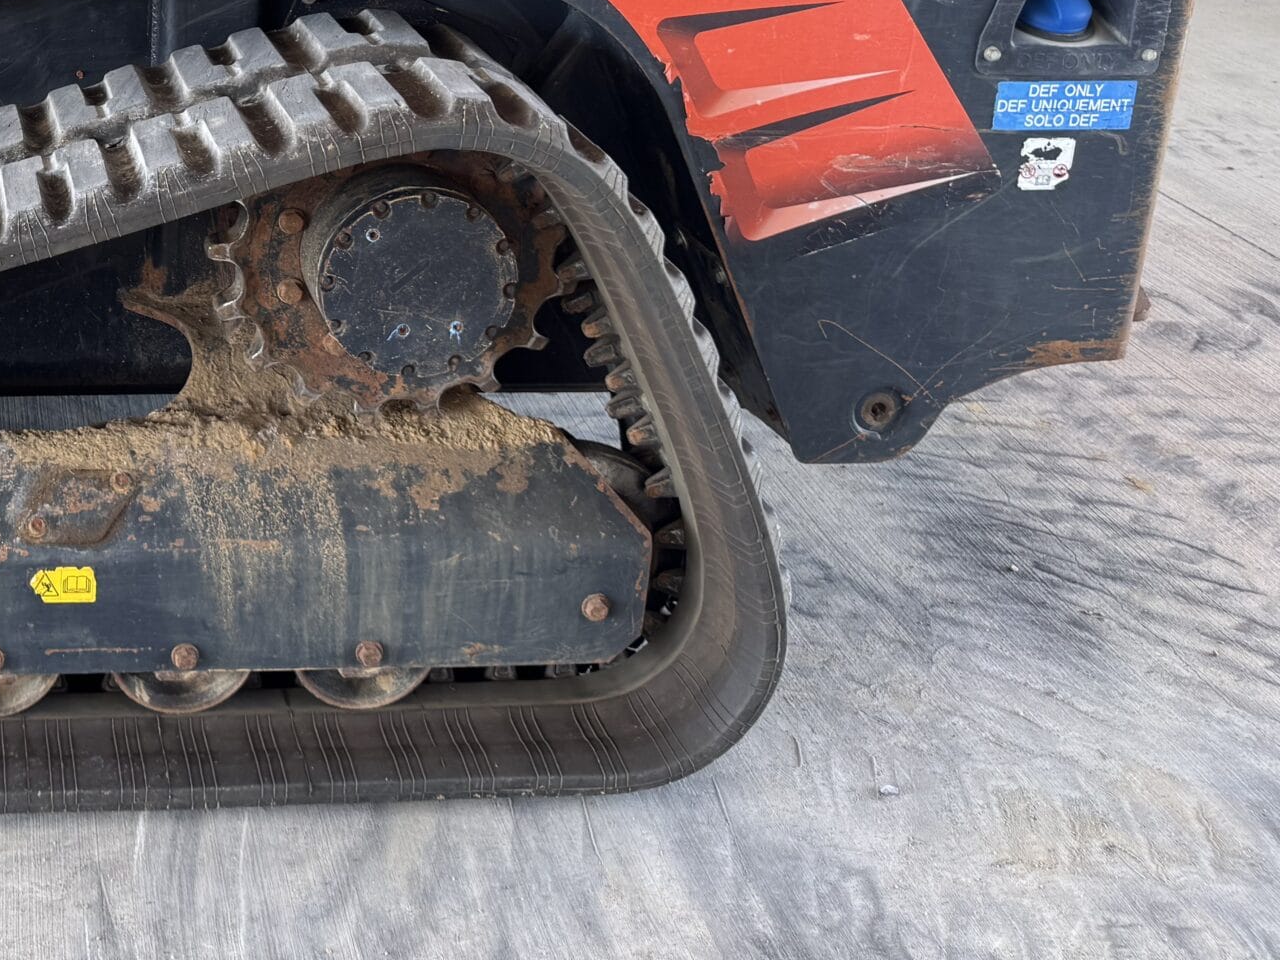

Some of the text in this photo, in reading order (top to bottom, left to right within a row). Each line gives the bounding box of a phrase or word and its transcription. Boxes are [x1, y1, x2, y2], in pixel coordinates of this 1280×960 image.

[1018, 53, 1058, 70] DEF
[1028, 84, 1104, 97] DEF ONLY
[997, 99, 1132, 113] DEF UNIQUEMENT
[1024, 114, 1100, 127] SOLO DEF
